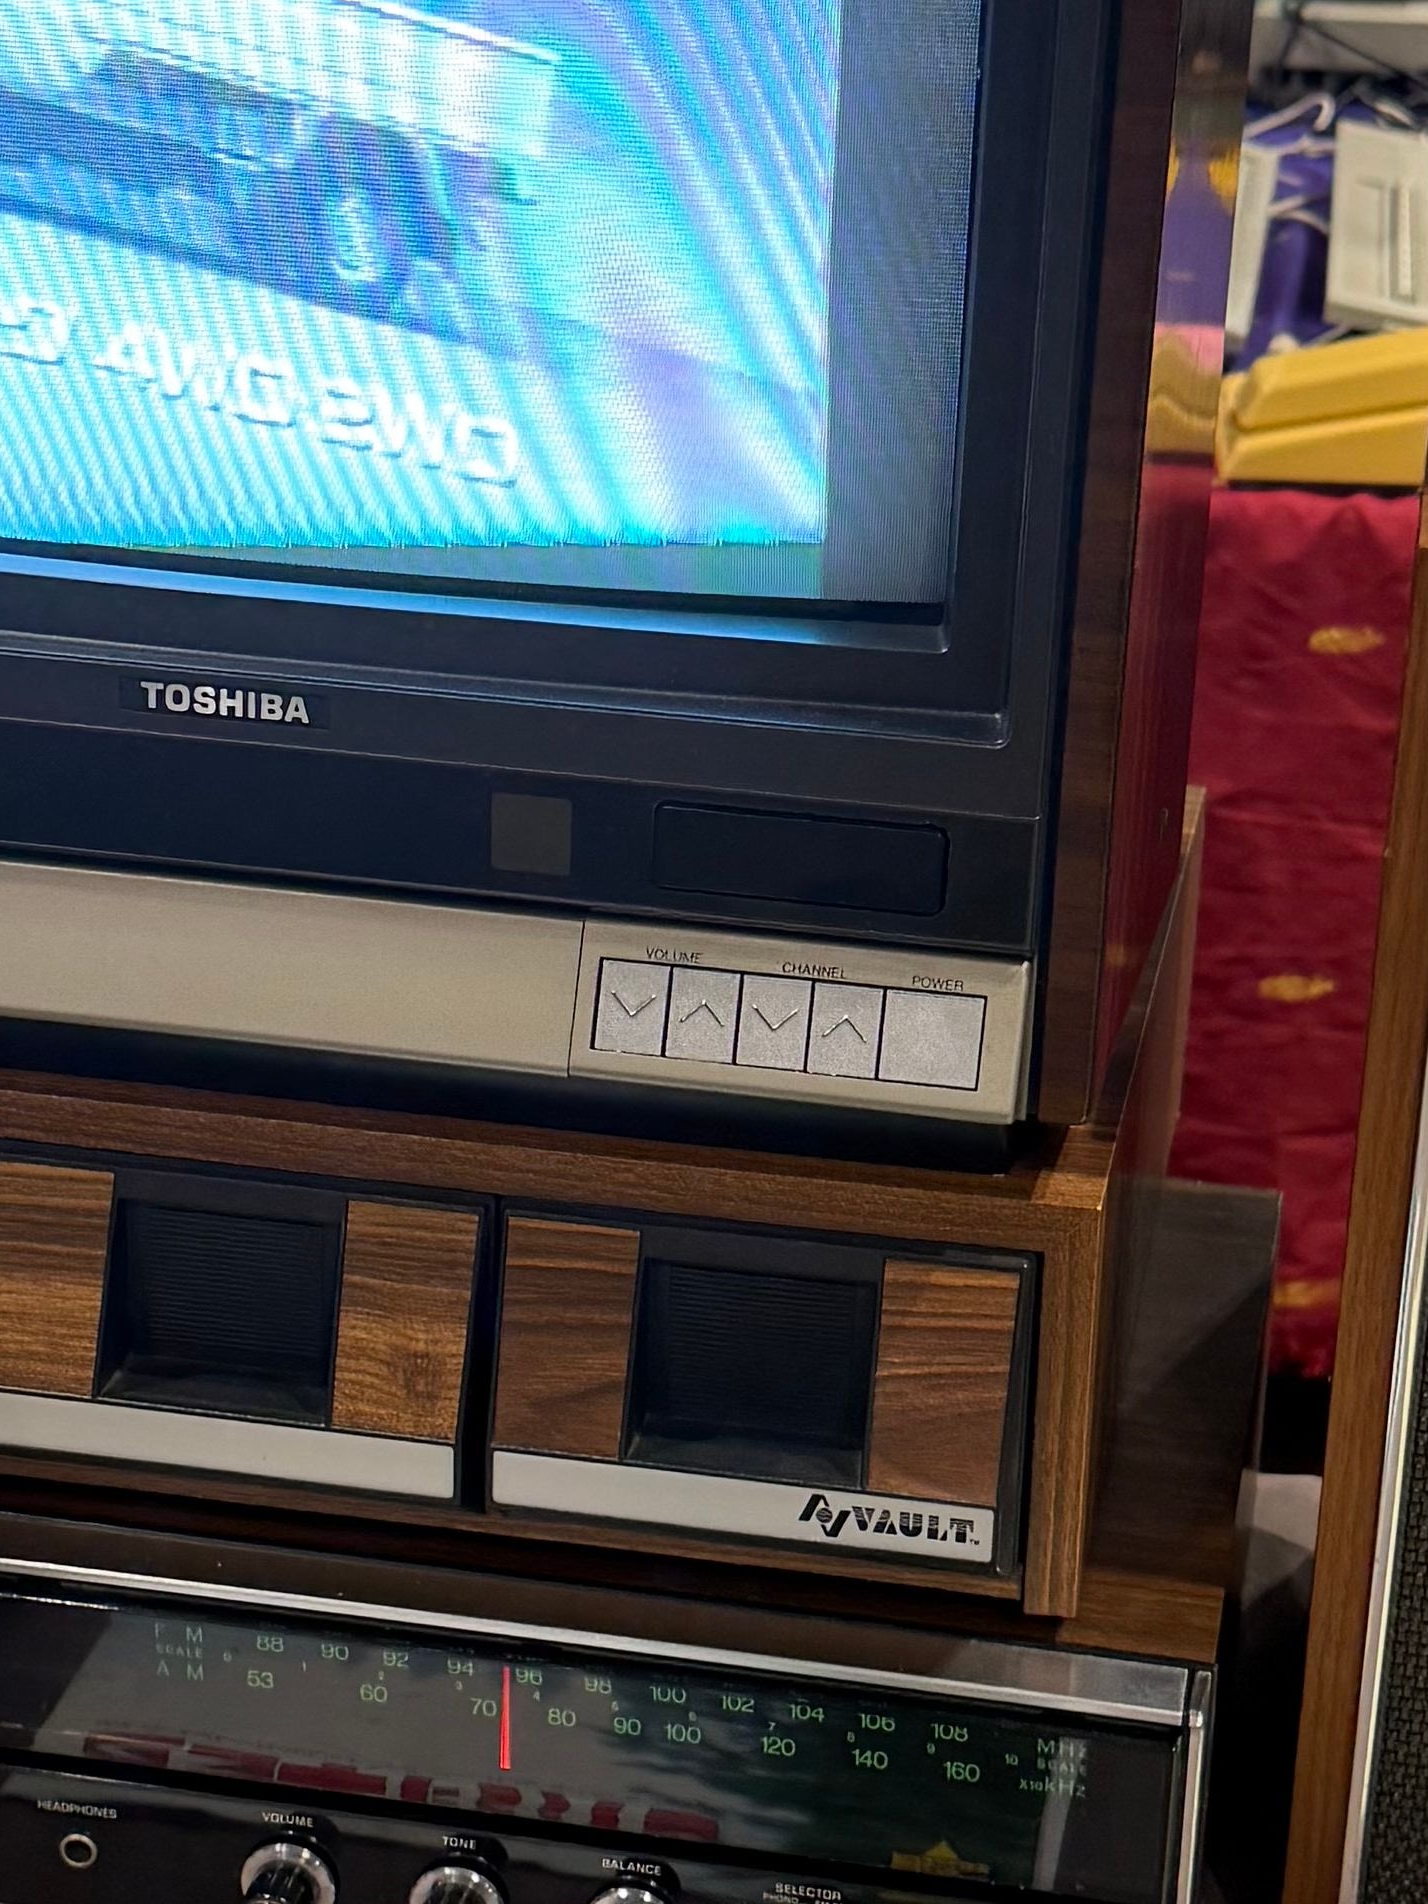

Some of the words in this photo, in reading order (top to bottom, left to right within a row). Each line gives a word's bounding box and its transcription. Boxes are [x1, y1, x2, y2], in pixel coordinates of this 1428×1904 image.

[140, 680, 310, 724] TOSHIBA
[645, 946, 702, 965] VOLUME
[781, 961, 847, 979] CHANNEL
[911, 974, 965, 992] POWER
[851, 1505, 975, 1545] VAULT
[246, 1669, 274, 1689] 53
[360, 1683, 388, 1704] 60
[470, 1698, 498, 1718] 70
[546, 1708, 577, 1728] 80
[612, 1715, 642, 1737] 90
[664, 1723, 702, 1745] 100
[760, 1735, 797, 1758] 120
[851, 1748, 889, 1771] 140
[943, 1760, 981, 1783] 160
[788, 1702, 826, 1724] 104
[858, 1711, 896, 1733] 106
[929, 1721, 969, 1744] 108
[36, 1798, 118, 1820] HEADPHONES
[260, 1811, 315, 1830] VOLUME
[441, 1834, 477, 1851] TONE
[600, 1857, 663, 1877] BALANCE
[775, 1881, 842, 1902] SELECTOR
